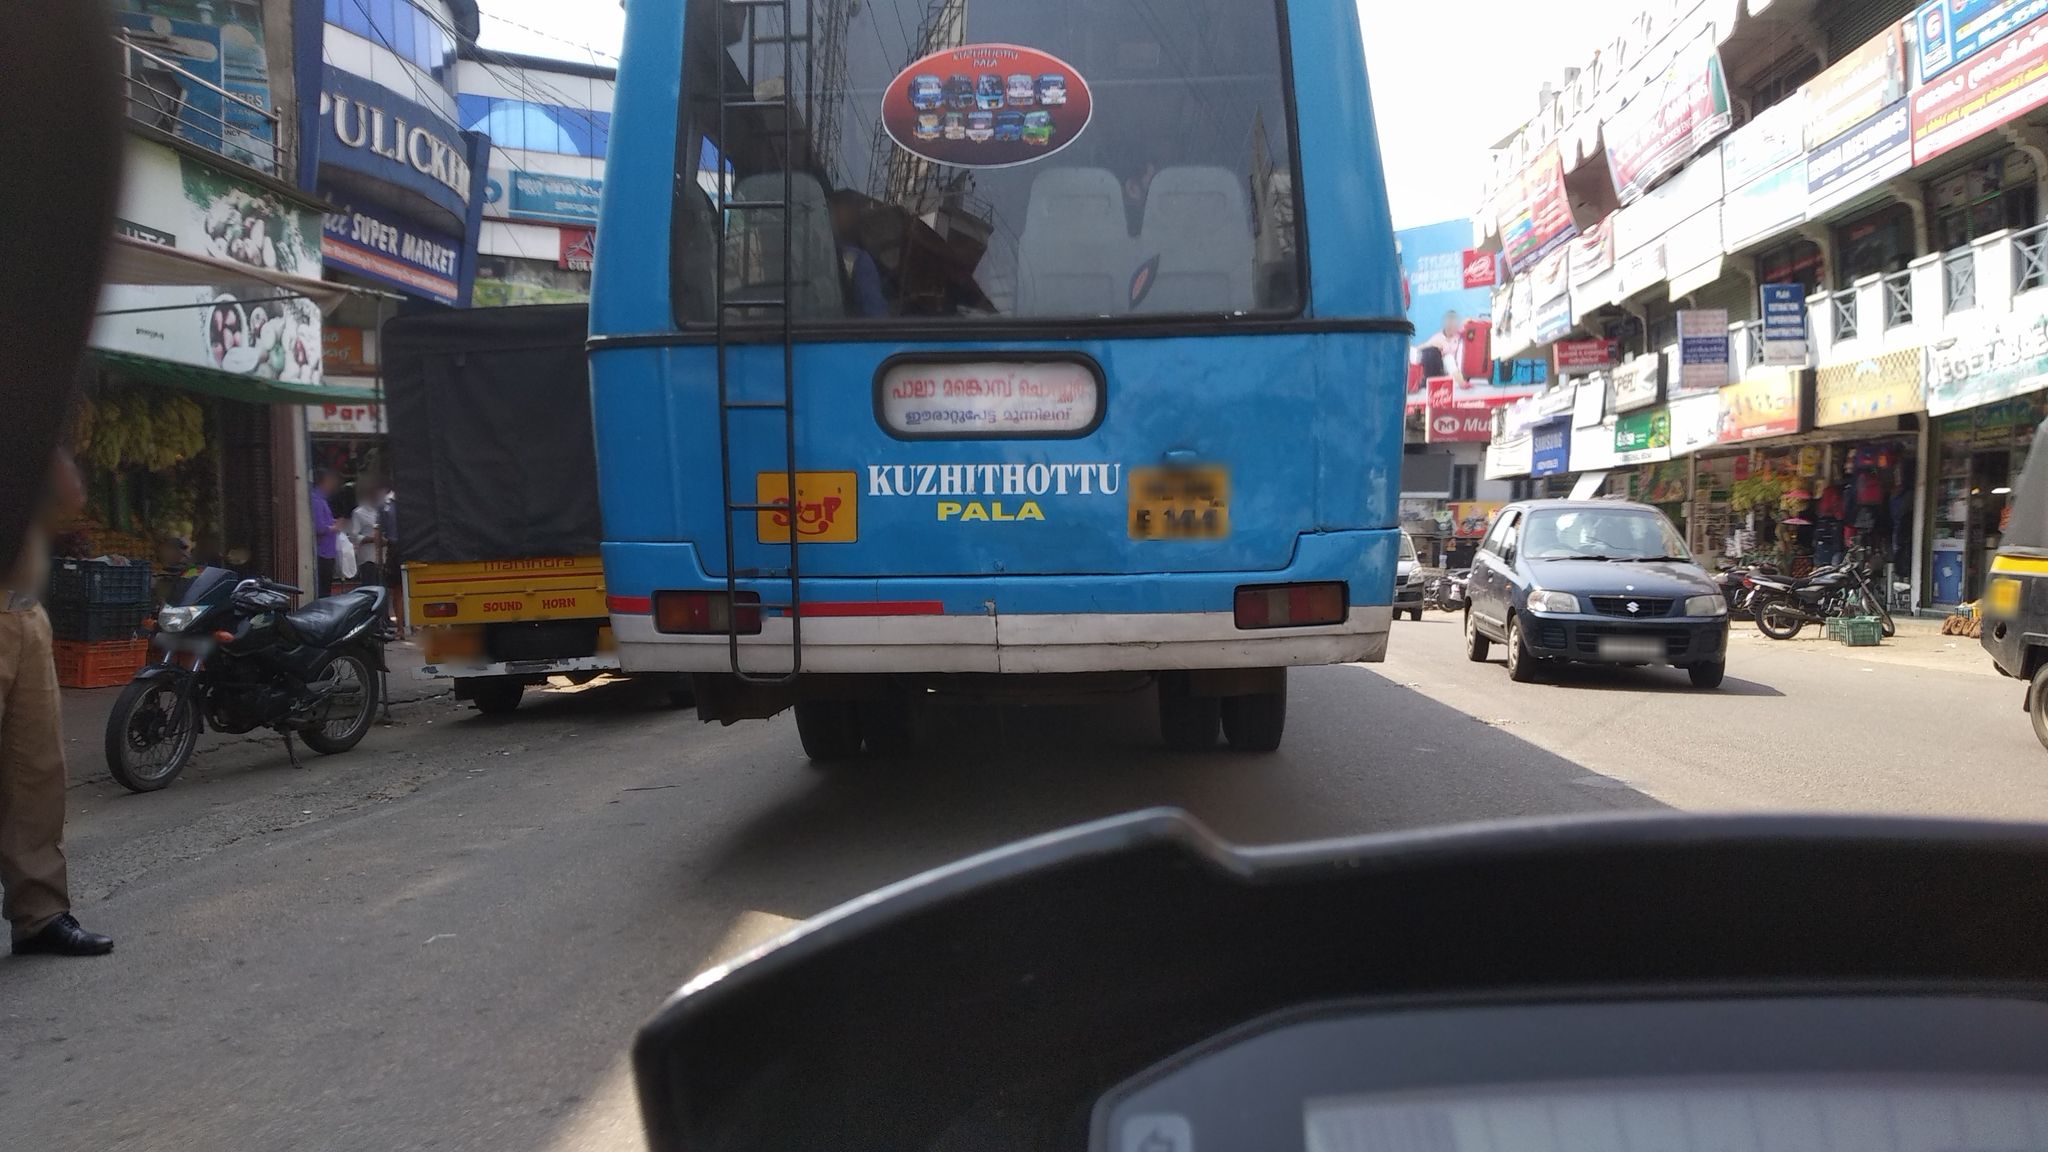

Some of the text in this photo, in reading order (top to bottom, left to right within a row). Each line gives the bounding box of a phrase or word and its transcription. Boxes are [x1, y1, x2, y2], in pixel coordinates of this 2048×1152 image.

[351, 213, 398, 256] SUPER
[401, 233, 456, 276] MARKET
[867, 462, 1121, 496] KUZHITHOTTU
[937, 502, 1046, 521] PALA
[483, 598, 576, 612] SOUND HORN
